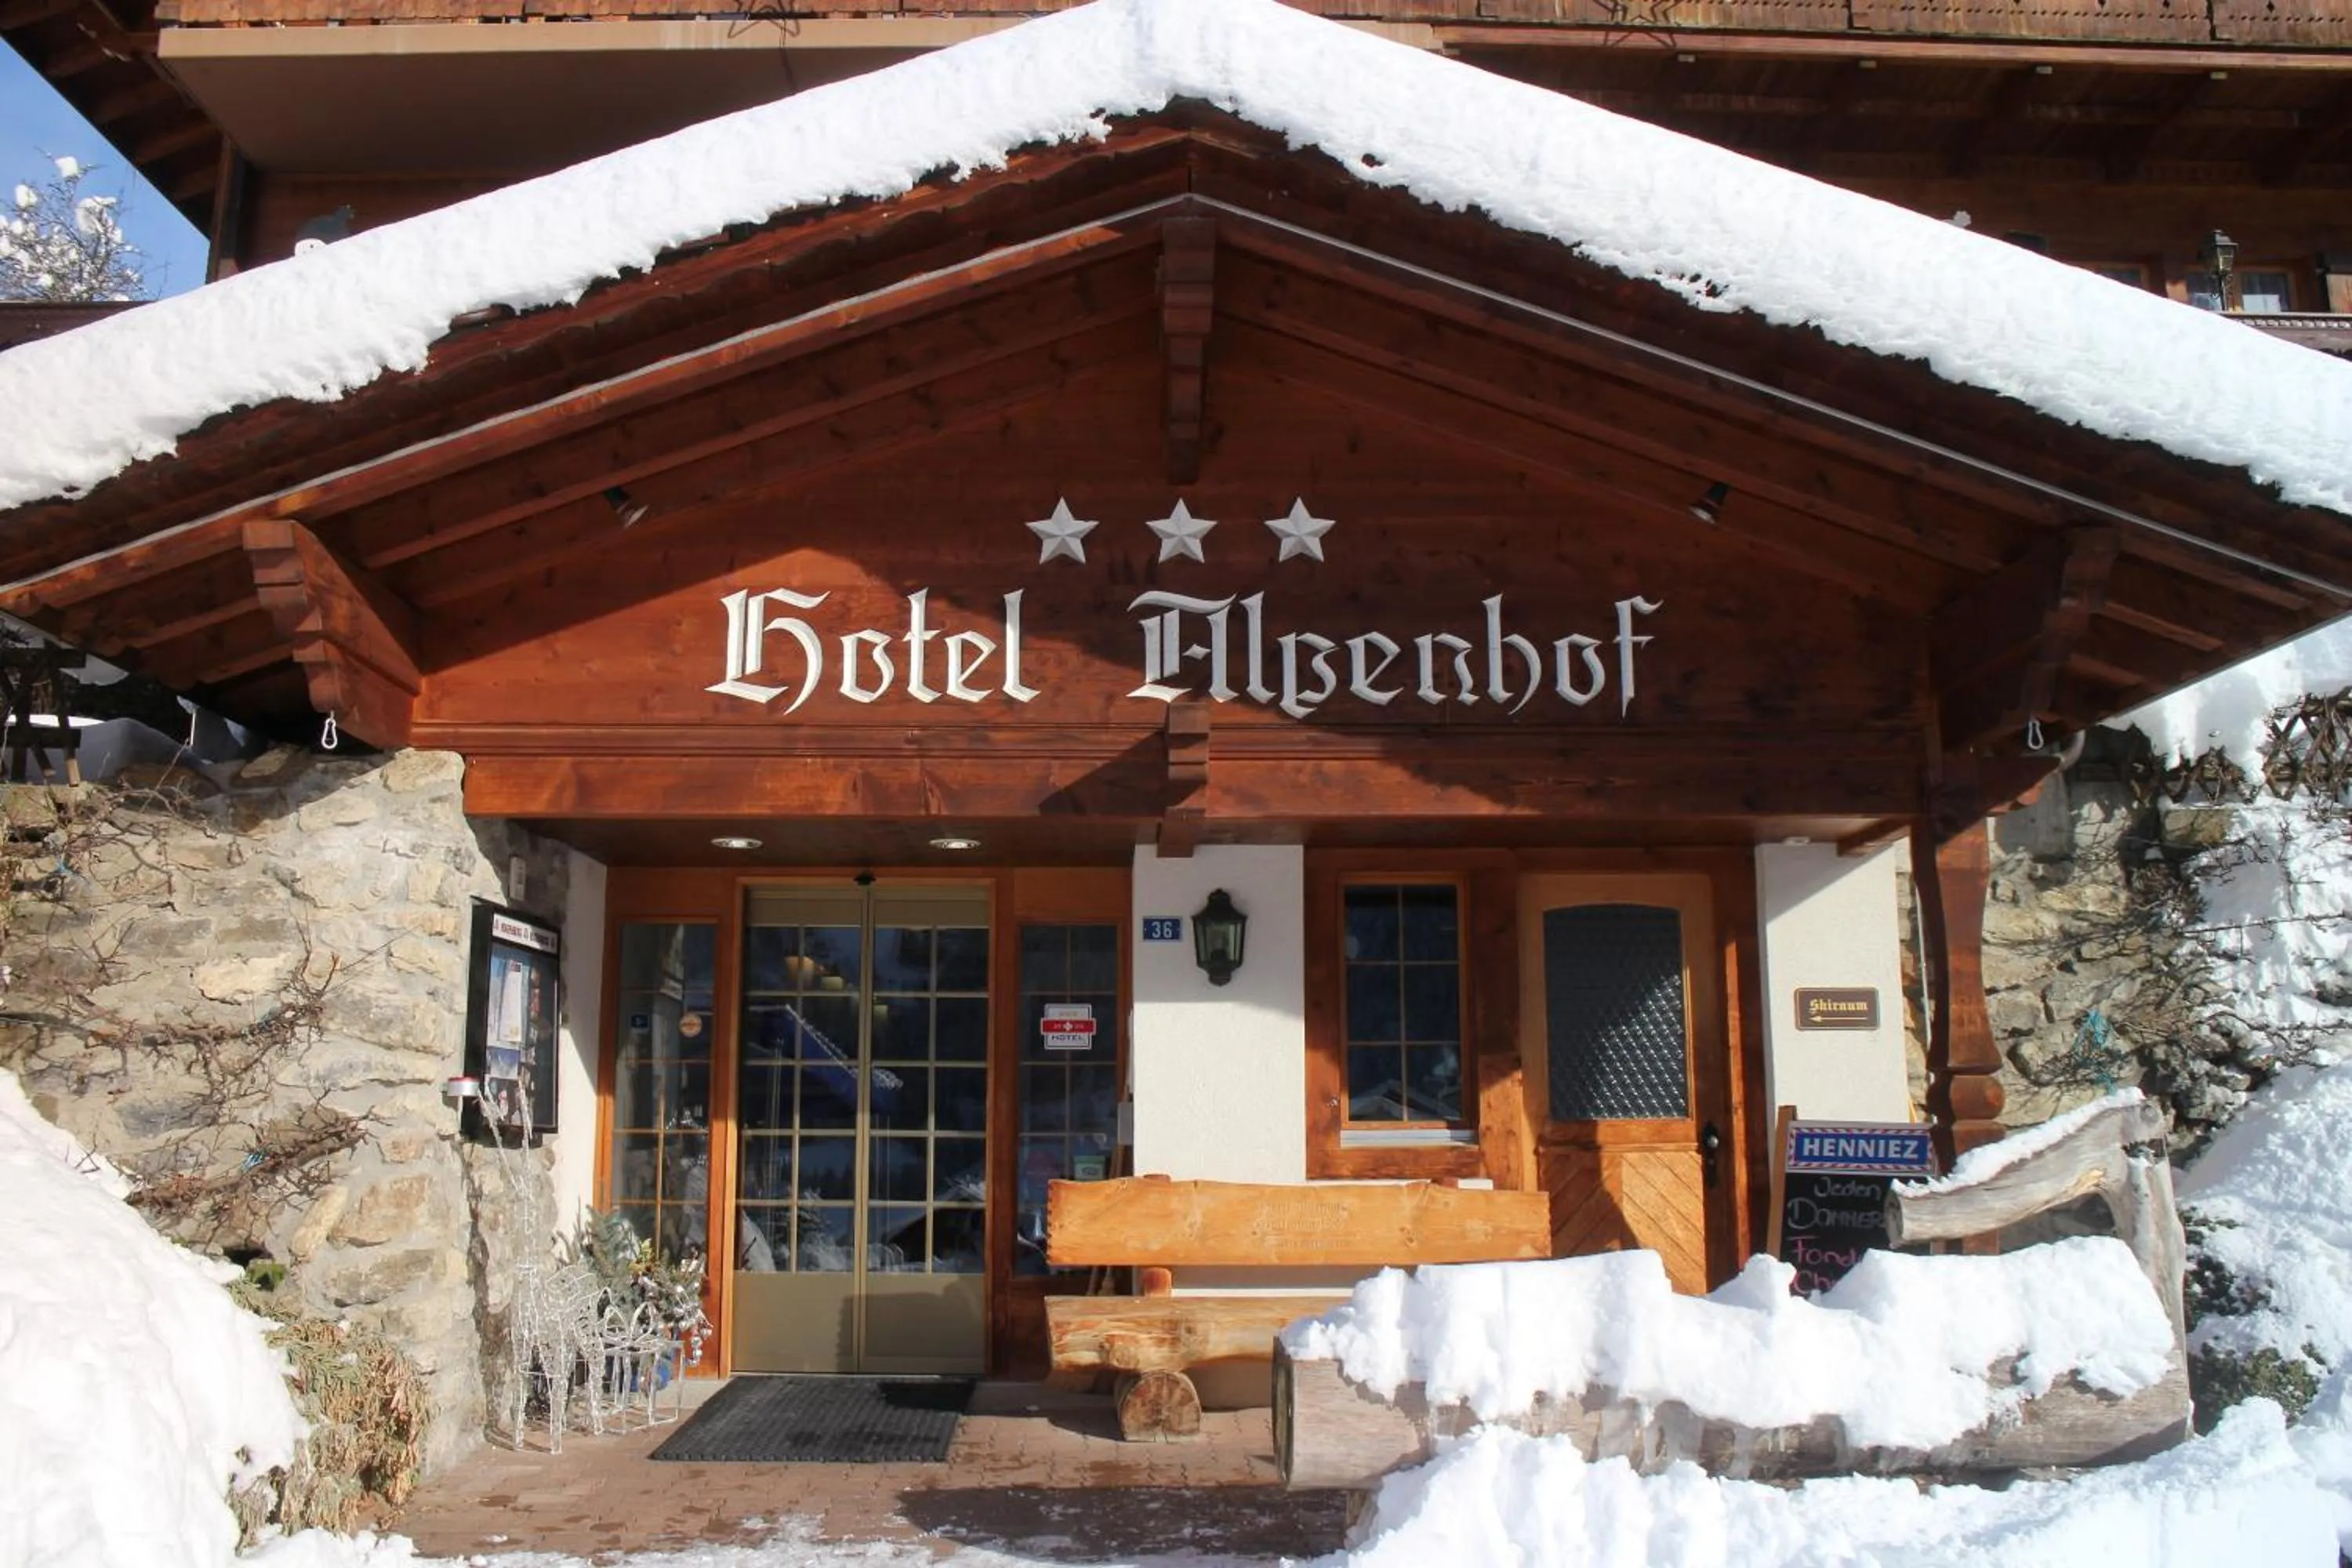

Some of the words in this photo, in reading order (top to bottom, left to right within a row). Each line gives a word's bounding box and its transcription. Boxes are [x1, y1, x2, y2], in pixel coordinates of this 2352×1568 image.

[705, 587, 1041, 715] Hotel
[1127, 590, 1663, 720] Alpenhof
[1151, 921, 1173, 938] 36
[1802, 1137, 1919, 1159] HENNIEZ
[1813, 1176, 1881, 1200] Jeden
[1786, 1235, 1863, 1267] Fond
